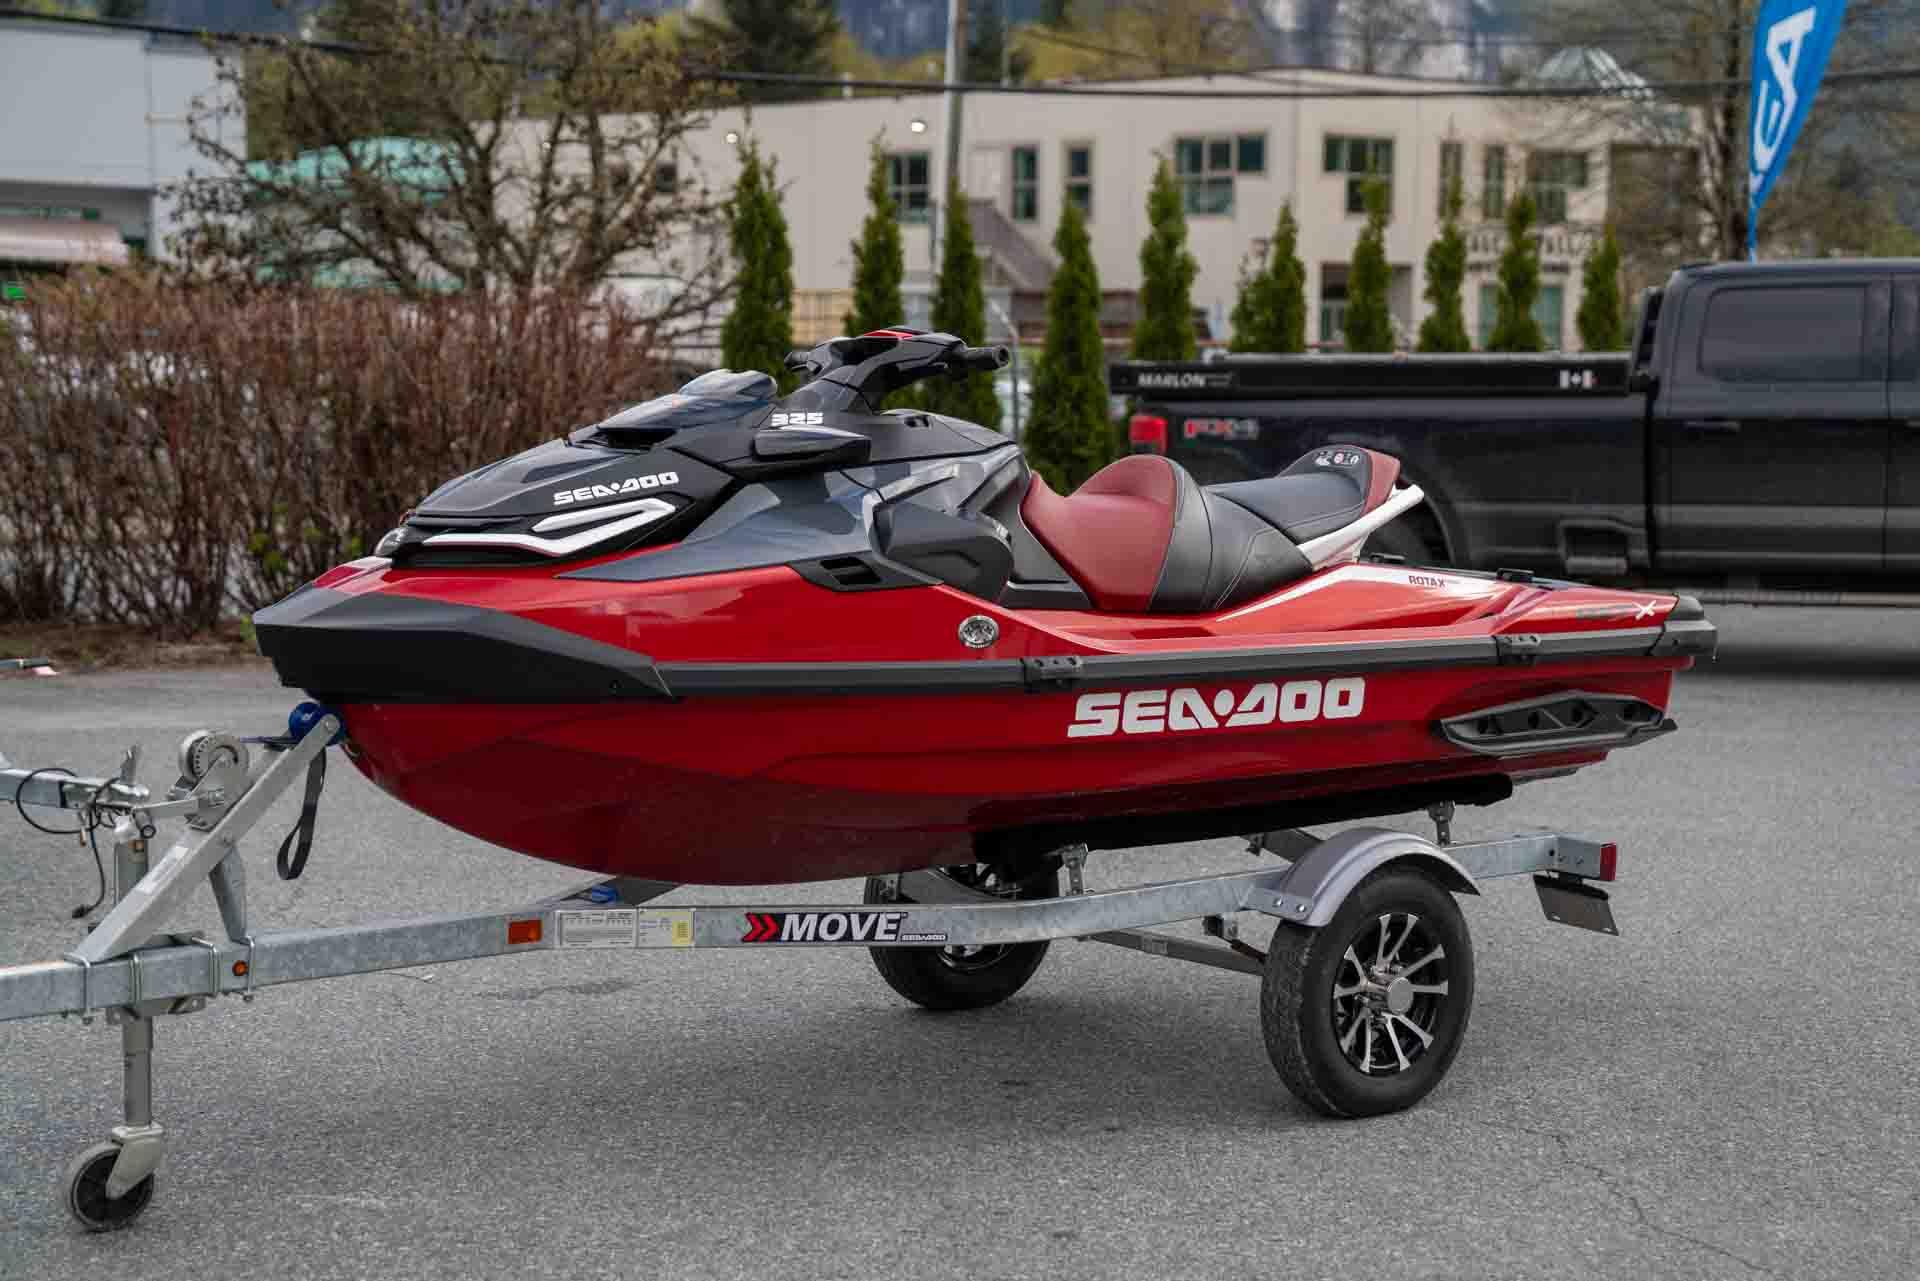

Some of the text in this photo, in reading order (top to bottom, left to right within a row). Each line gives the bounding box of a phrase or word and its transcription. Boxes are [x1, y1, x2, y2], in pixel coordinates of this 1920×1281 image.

[771, 412, 825, 426] 325
[1409, 575, 1446, 588] ROTAX
[781, 912, 900, 942] MOVE
